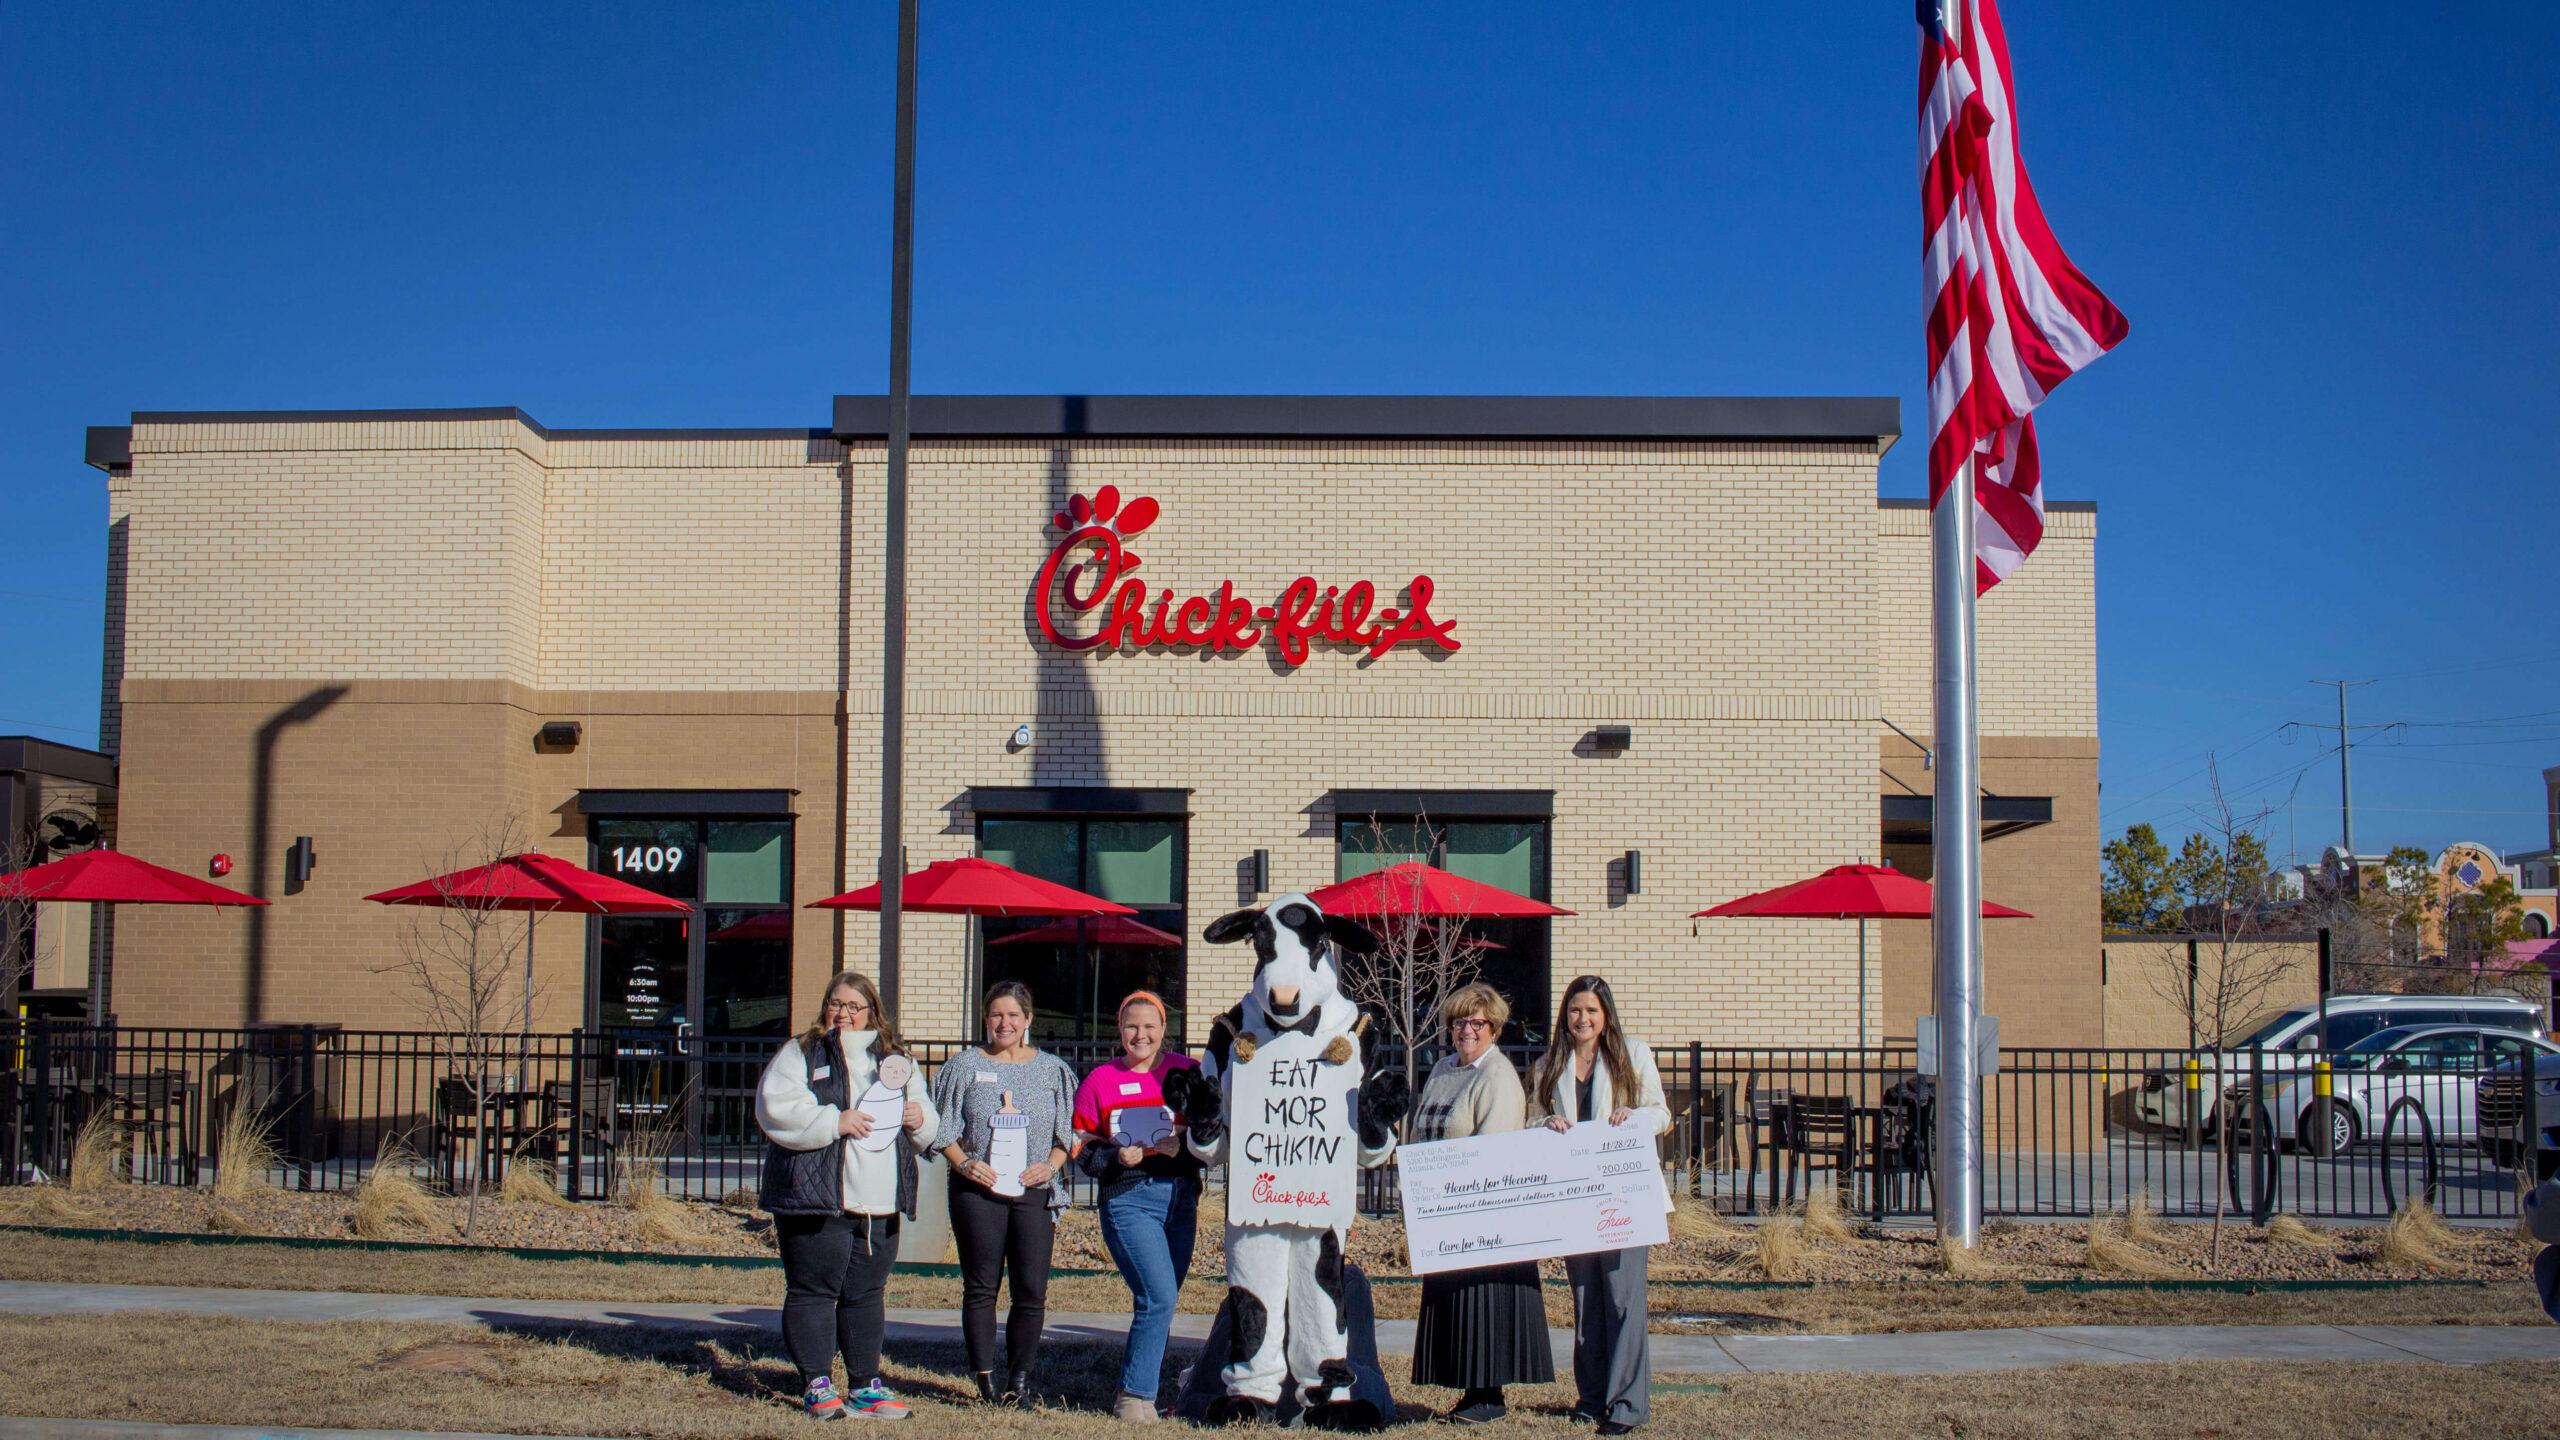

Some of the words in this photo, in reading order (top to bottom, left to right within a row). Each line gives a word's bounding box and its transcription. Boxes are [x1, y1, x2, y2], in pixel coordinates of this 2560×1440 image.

[1036, 500, 1461, 666] Chick-fil-A
[612, 846, 682, 872] 1409
[629, 978, 658, 986] 6:30am
[627, 995, 659, 1004] 10:00pm
[1269, 1057, 1328, 1089] EAT
[1265, 1095, 1327, 1131] MOR
[1245, 1132, 1341, 1167] CHIKIN
[1570, 1148, 1590, 1157] Date
[1602, 1138, 1637, 1151] 11/28/22
[1252, 1174, 1330, 1206] Chick-fil-A
[1444, 1178, 1480, 1194] Hearts
[1483, 1177, 1500, 1192] for
[1502, 1173, 1549, 1187] Hearing
[1416, 1205, 1435, 1215] Two
[1436, 1199, 1476, 1213] hundred
[1478, 1194, 1521, 1207] thousand
[1522, 1189, 1557, 1201] dollars
[1566, 1183, 1605, 1195] 00/100
[1621, 1183, 1650, 1194] Dollars
[1596, 1208, 1632, 1231] True
[1438, 1240, 1460, 1253] Care
[1461, 1238, 1474, 1253] for
[1477, 1233, 1504, 1250] People
